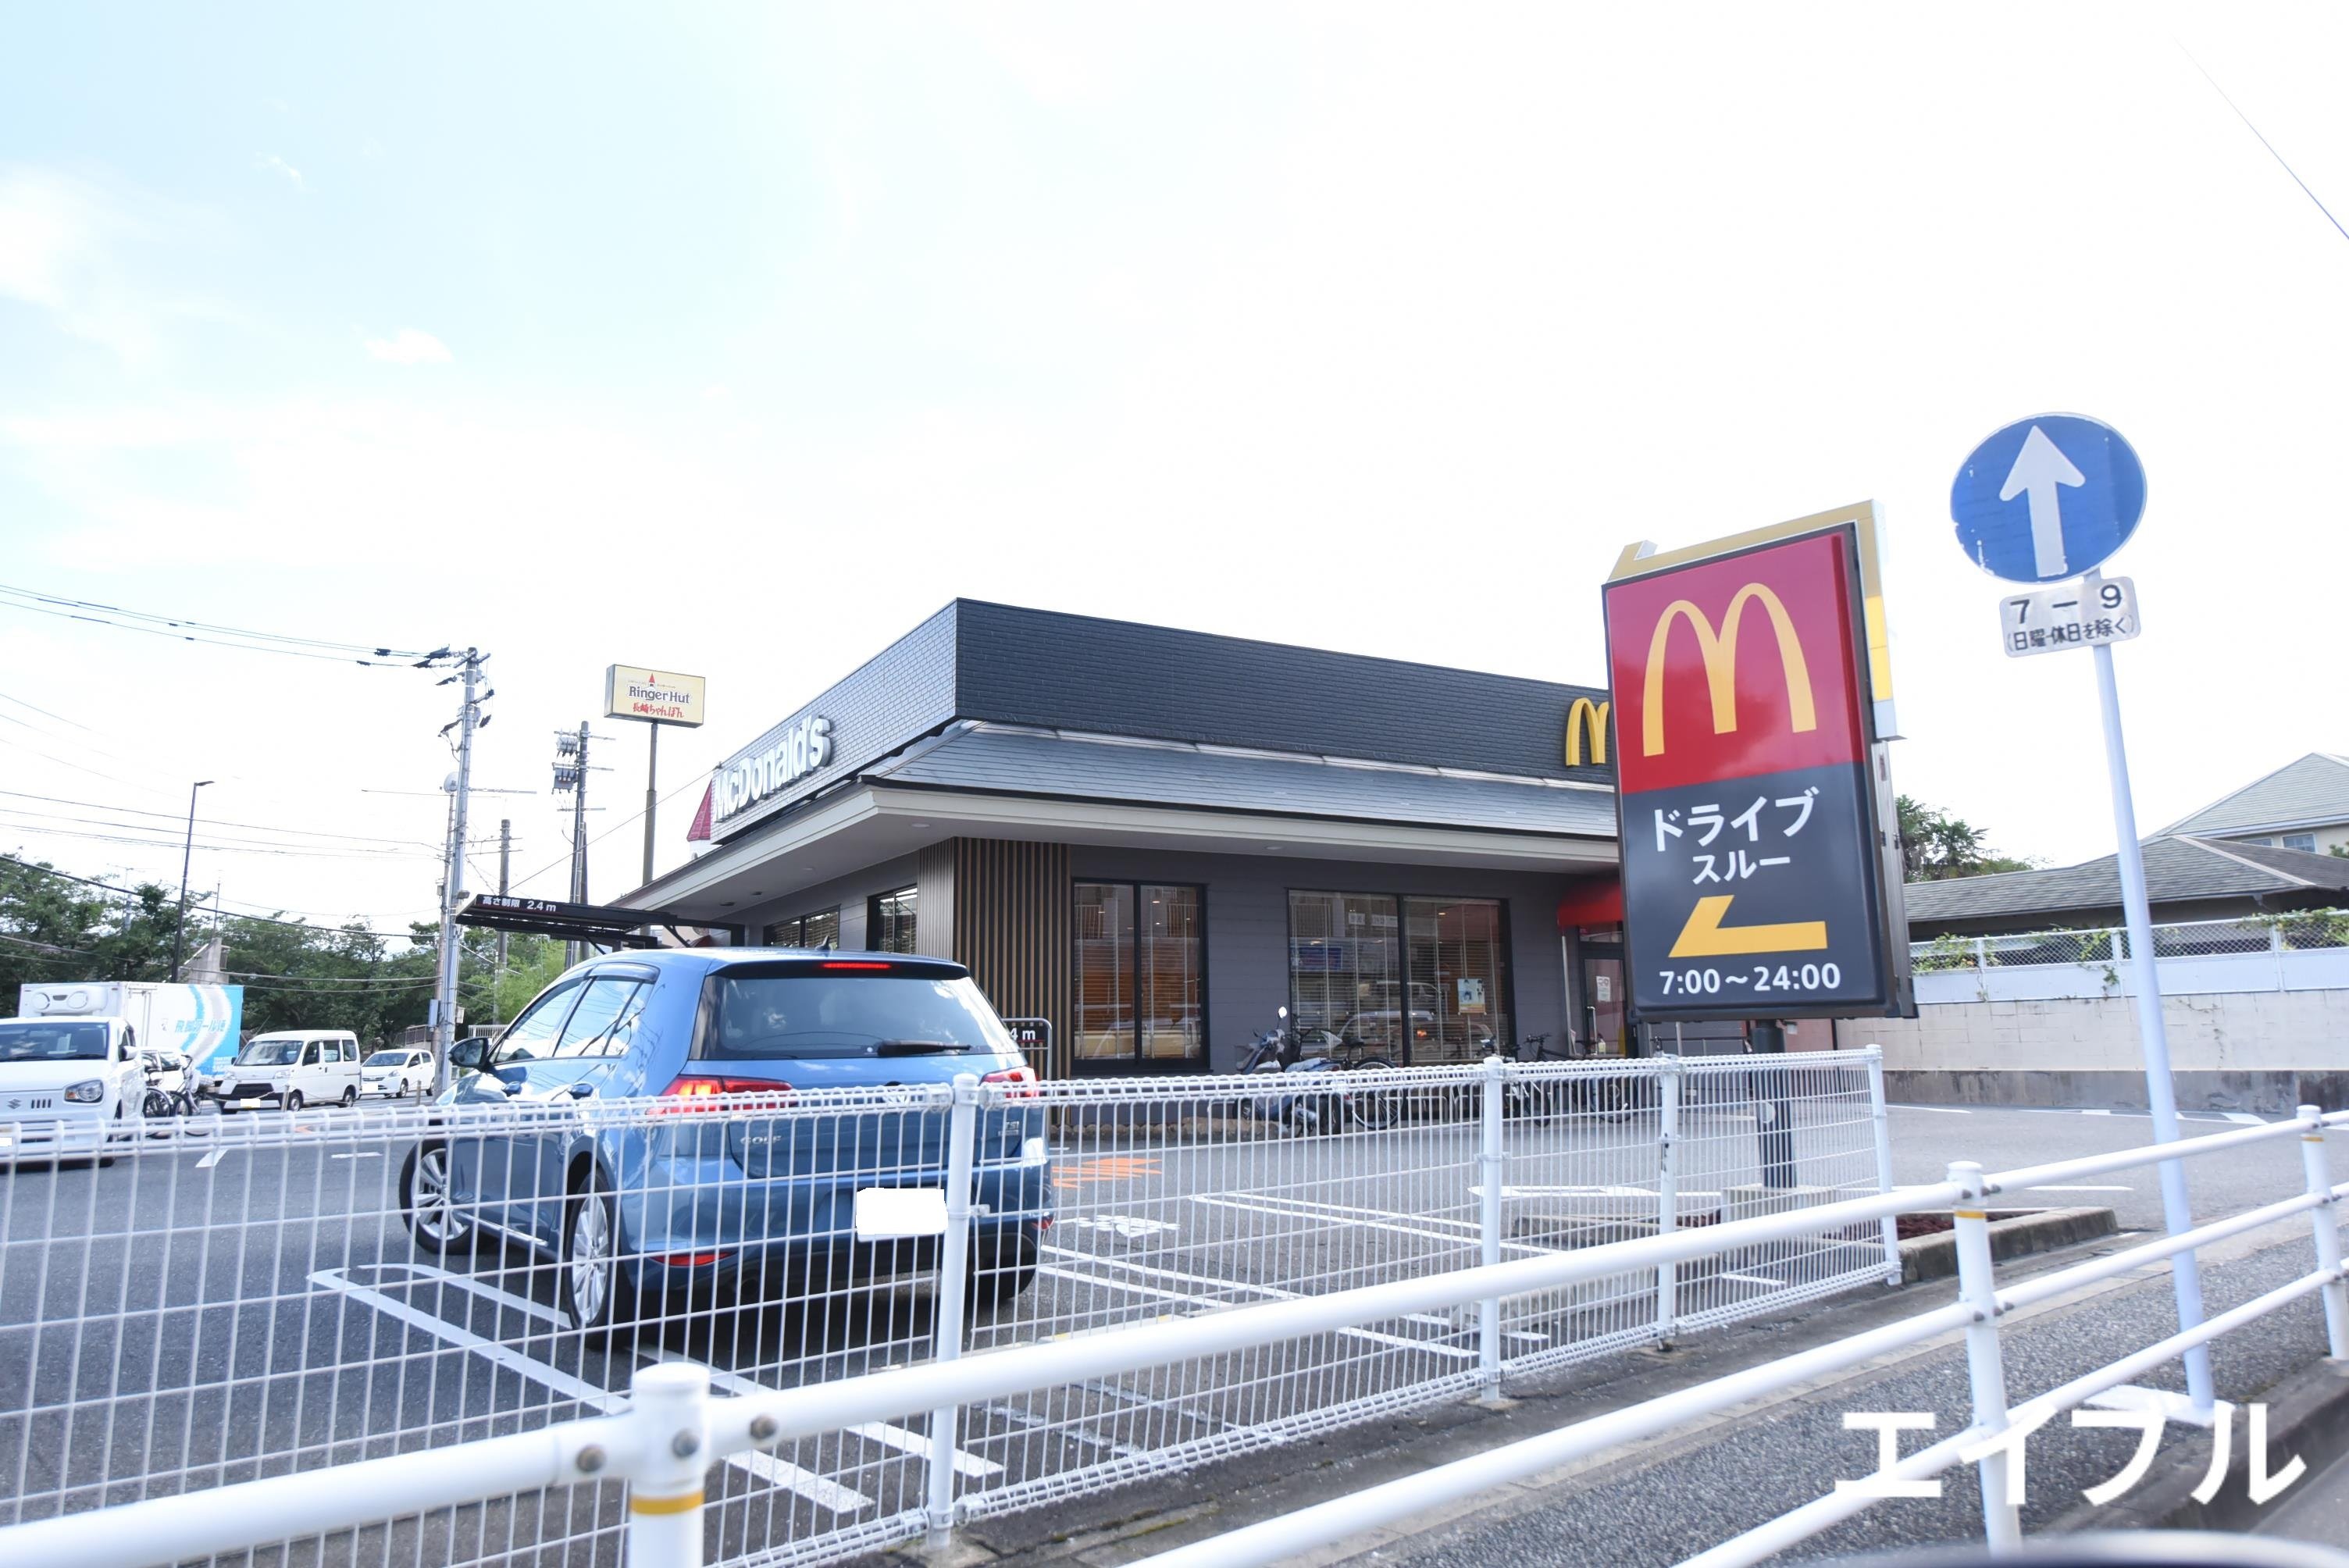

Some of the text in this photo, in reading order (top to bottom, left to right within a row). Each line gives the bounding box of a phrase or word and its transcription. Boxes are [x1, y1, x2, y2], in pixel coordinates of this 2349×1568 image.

[629, 686, 690, 704] Ringer Hut
[633, 702, 684, 718] 長崎ちゃんぽん
[712, 715, 831, 822] McDonald's
[1654, 786, 1820, 852] ドライブ
[1692, 850, 1791, 885] スルー
[483, 896, 520, 907] 高さ制限
[740, 1135, 782, 1145] GOLF
